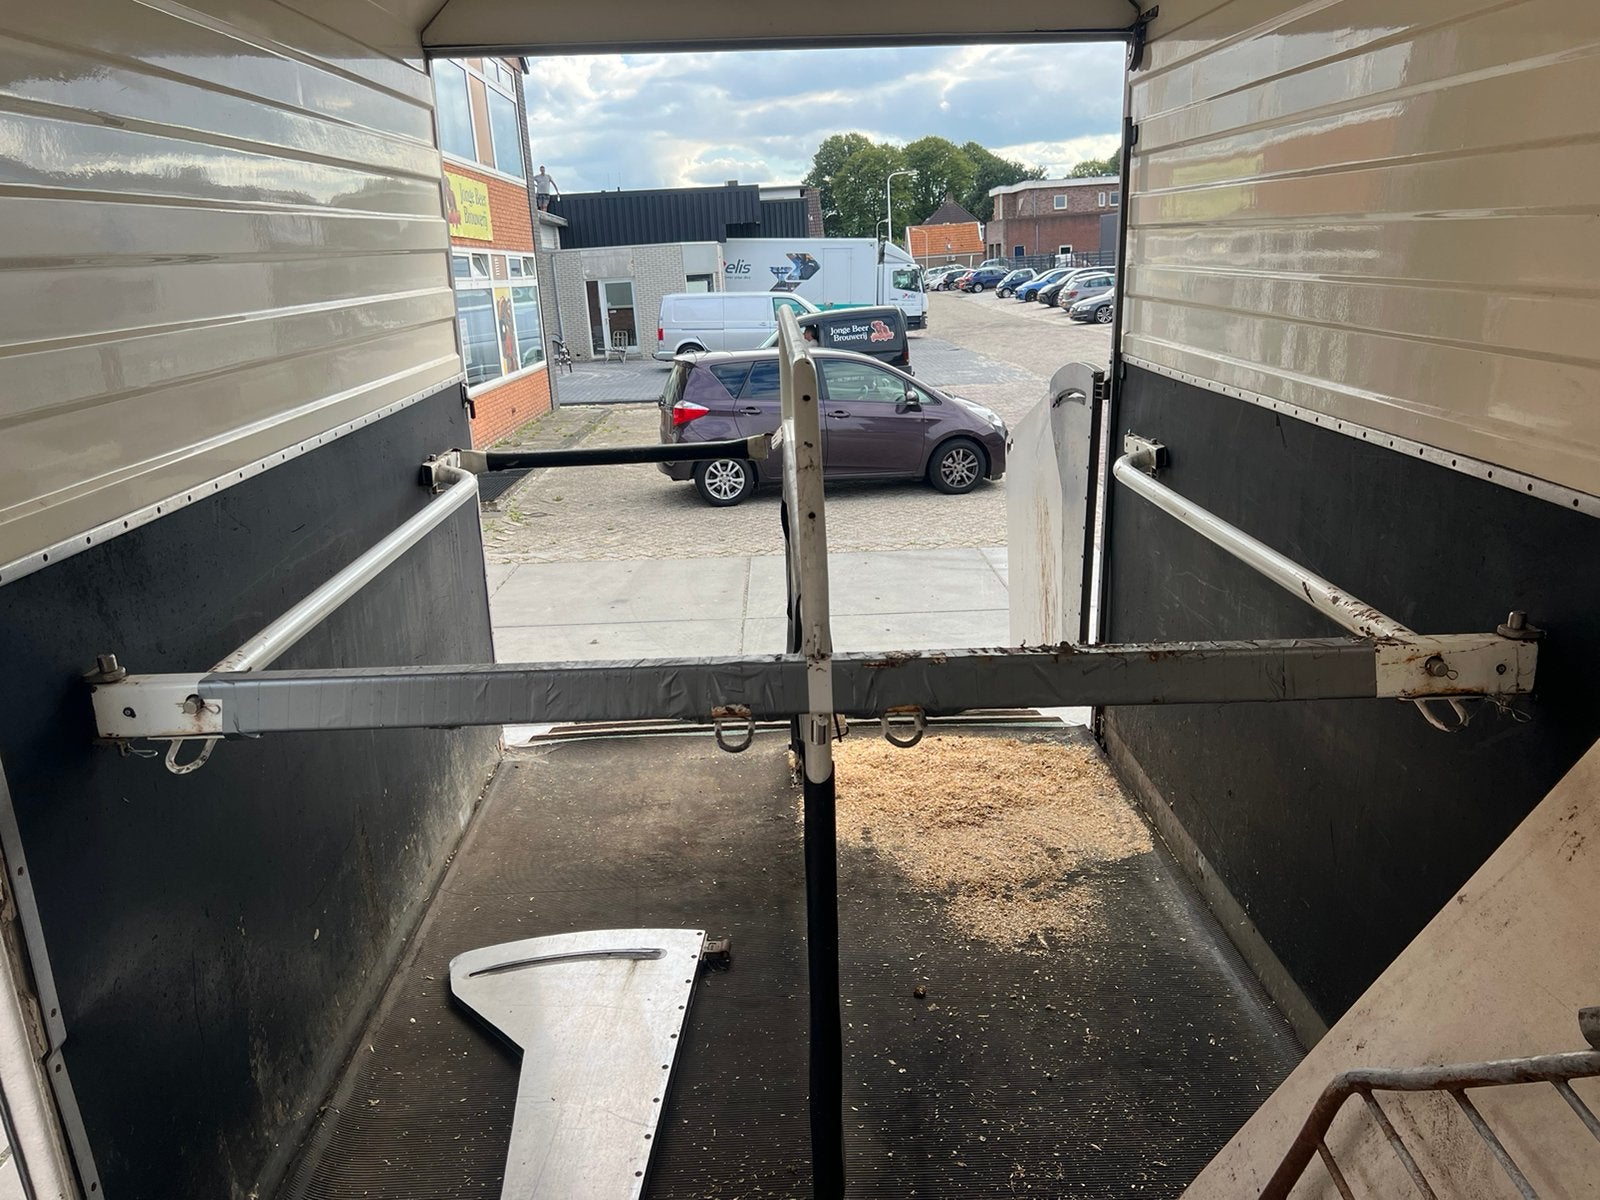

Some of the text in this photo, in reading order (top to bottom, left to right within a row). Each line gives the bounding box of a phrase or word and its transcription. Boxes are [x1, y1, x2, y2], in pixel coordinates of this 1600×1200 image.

[458, 183, 486, 207] Jonge Beer
[464, 205, 488, 231] Brouwerij
[723, 259, 751, 273] elis
[830, 327, 851, 335] Jonge
[833, 332, 868, 341] Brouwerij
